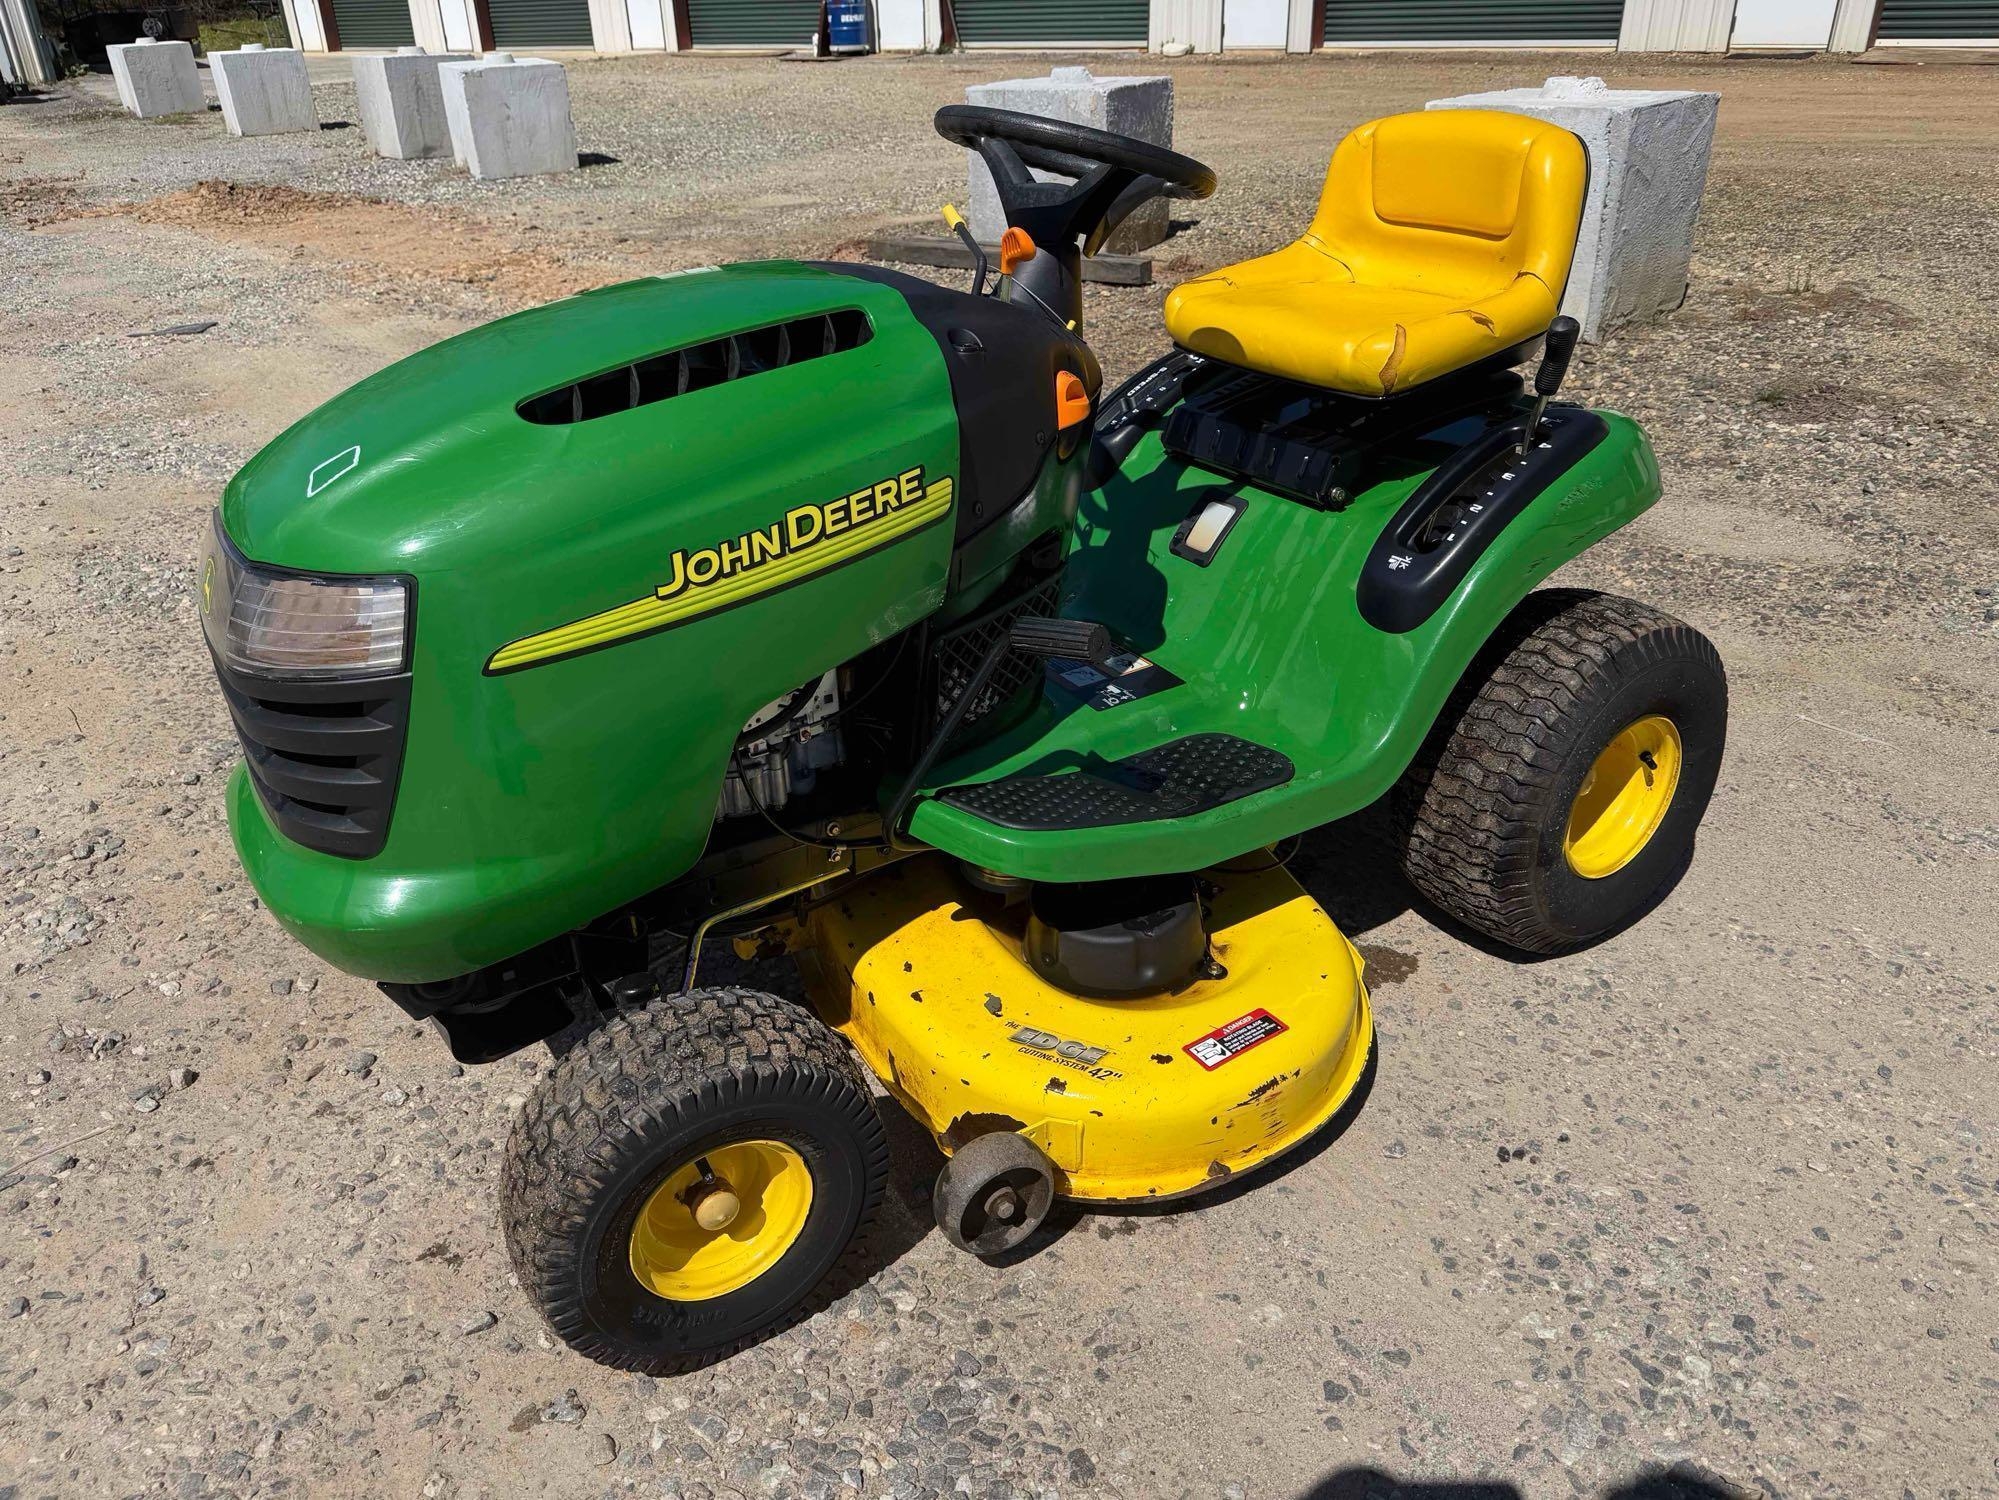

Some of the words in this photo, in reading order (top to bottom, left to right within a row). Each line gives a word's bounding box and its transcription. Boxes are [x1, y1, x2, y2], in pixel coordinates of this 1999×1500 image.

[655, 520, 782, 599] JOHN
[785, 466, 924, 550] DEERE
[1004, 1020, 1021, 1030] THE
[1222, 1027, 1248, 1042] ROTATING
[1226, 1015, 1254, 1031] DANGER
[1007, 1026, 1110, 1065] EDGE
[1018, 1046, 1055, 1062] CUTTING
[1053, 1056, 1090, 1072] SYSTEM
[1087, 1067, 1123, 1081] 42"
